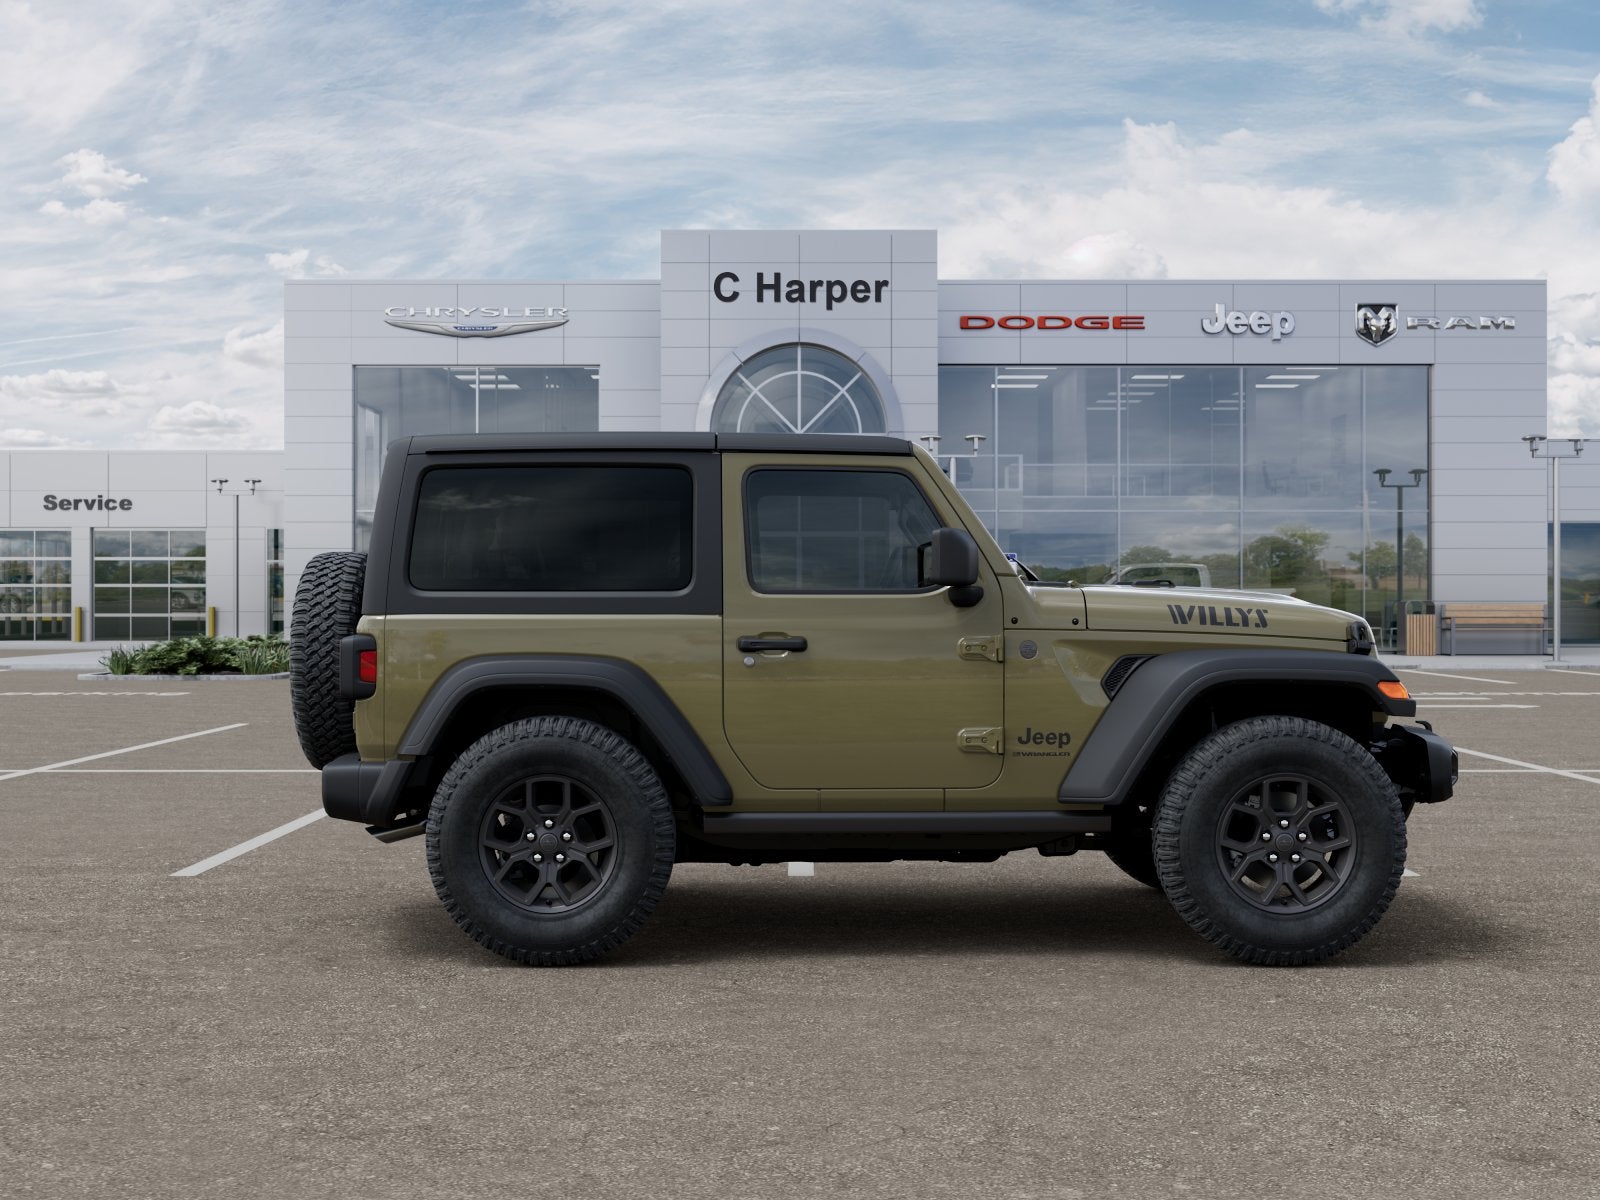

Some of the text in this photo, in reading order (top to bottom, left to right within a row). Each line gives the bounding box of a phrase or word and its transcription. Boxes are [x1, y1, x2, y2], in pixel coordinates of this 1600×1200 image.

[713, 271, 890, 311] C Harper
[384, 306, 568, 318] CHRYSLER
[959, 315, 1146, 330] DODGE
[1201, 303, 1296, 342] Jeep
[1406, 315, 1516, 330] RAM
[43, 494, 133, 511] Service
[1167, 604, 1269, 629] WILLYS
[1017, 727, 1071, 749] Jeep
